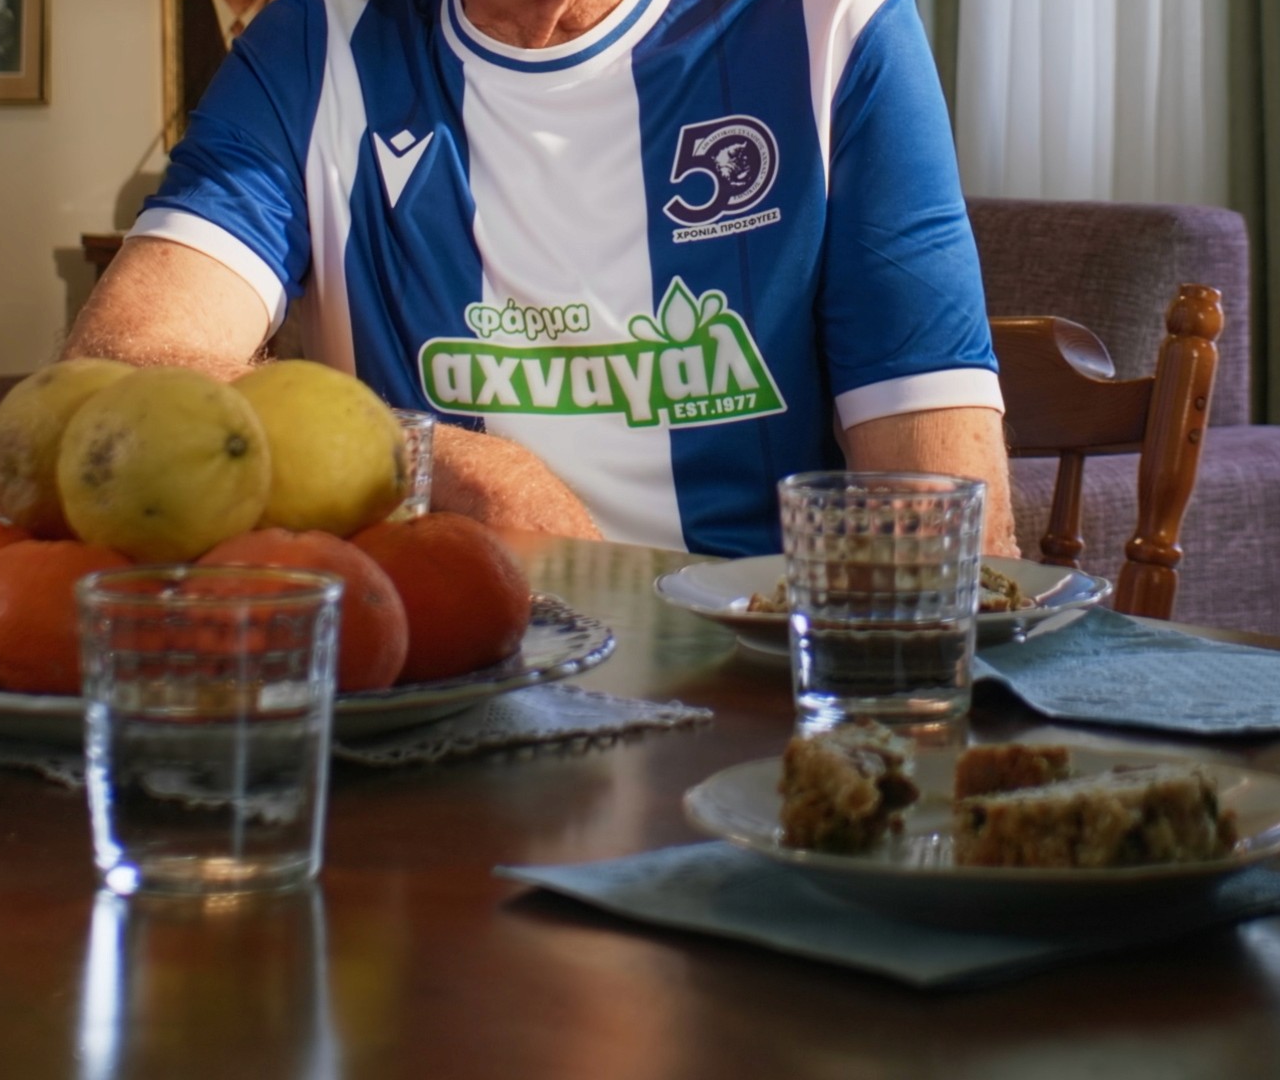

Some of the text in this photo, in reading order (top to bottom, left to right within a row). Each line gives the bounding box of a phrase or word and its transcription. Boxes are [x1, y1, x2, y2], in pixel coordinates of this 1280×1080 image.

[664, 115, 779, 226] 50
[676, 211, 778, 241] ΧΡΟΝΙΑ ΠΡΟΣΦΥΓΕΣ
[470, 298, 590, 341] φάρμα
[673, 393, 757, 419] EST.1977
